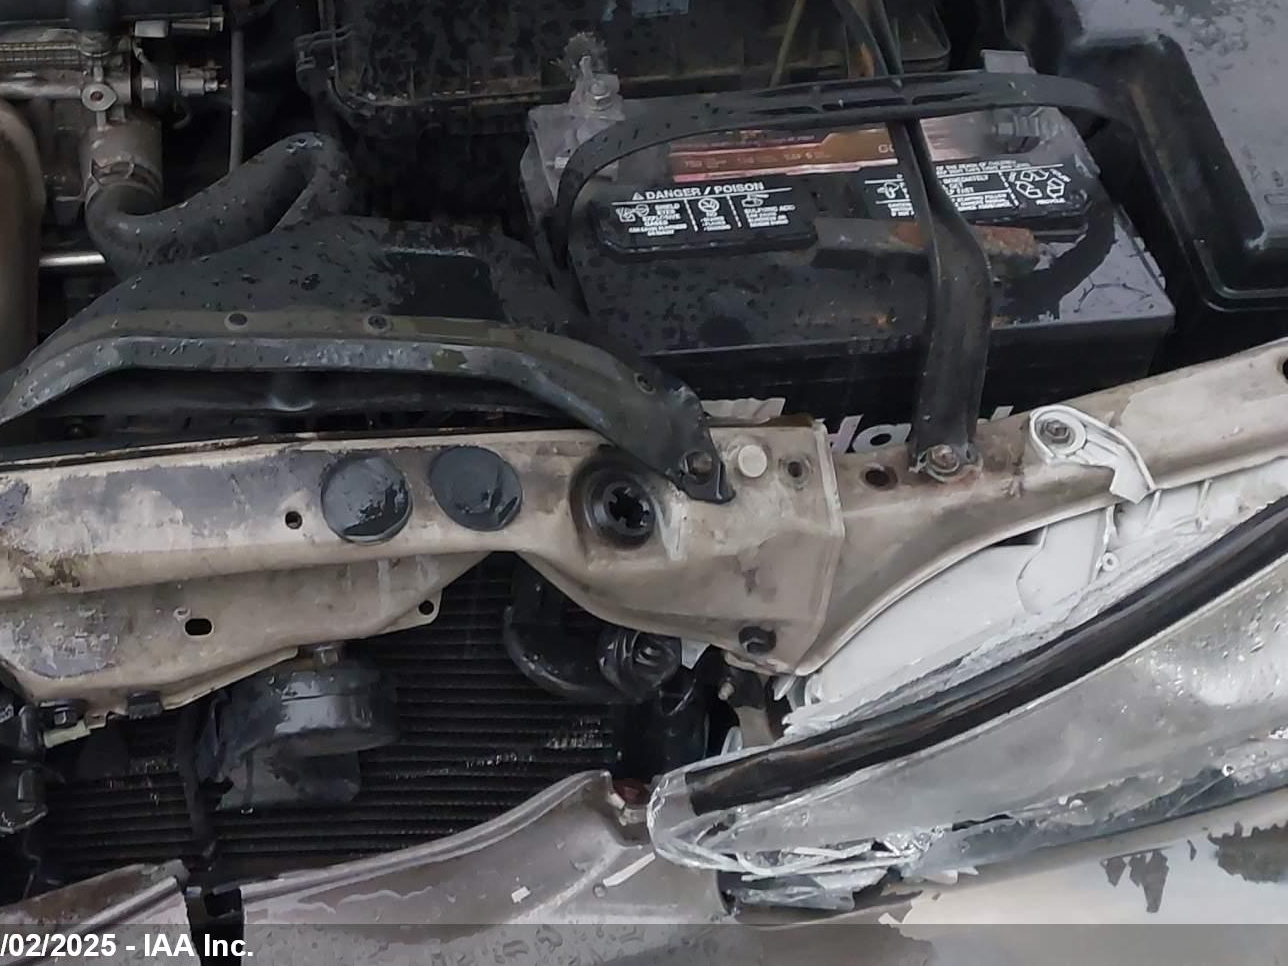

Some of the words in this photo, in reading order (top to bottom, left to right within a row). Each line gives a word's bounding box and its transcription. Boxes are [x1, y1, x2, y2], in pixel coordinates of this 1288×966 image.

[645, 187, 701, 200] DANGER
[704, 186, 711, 195] /
[714, 182, 764, 194] POISON
